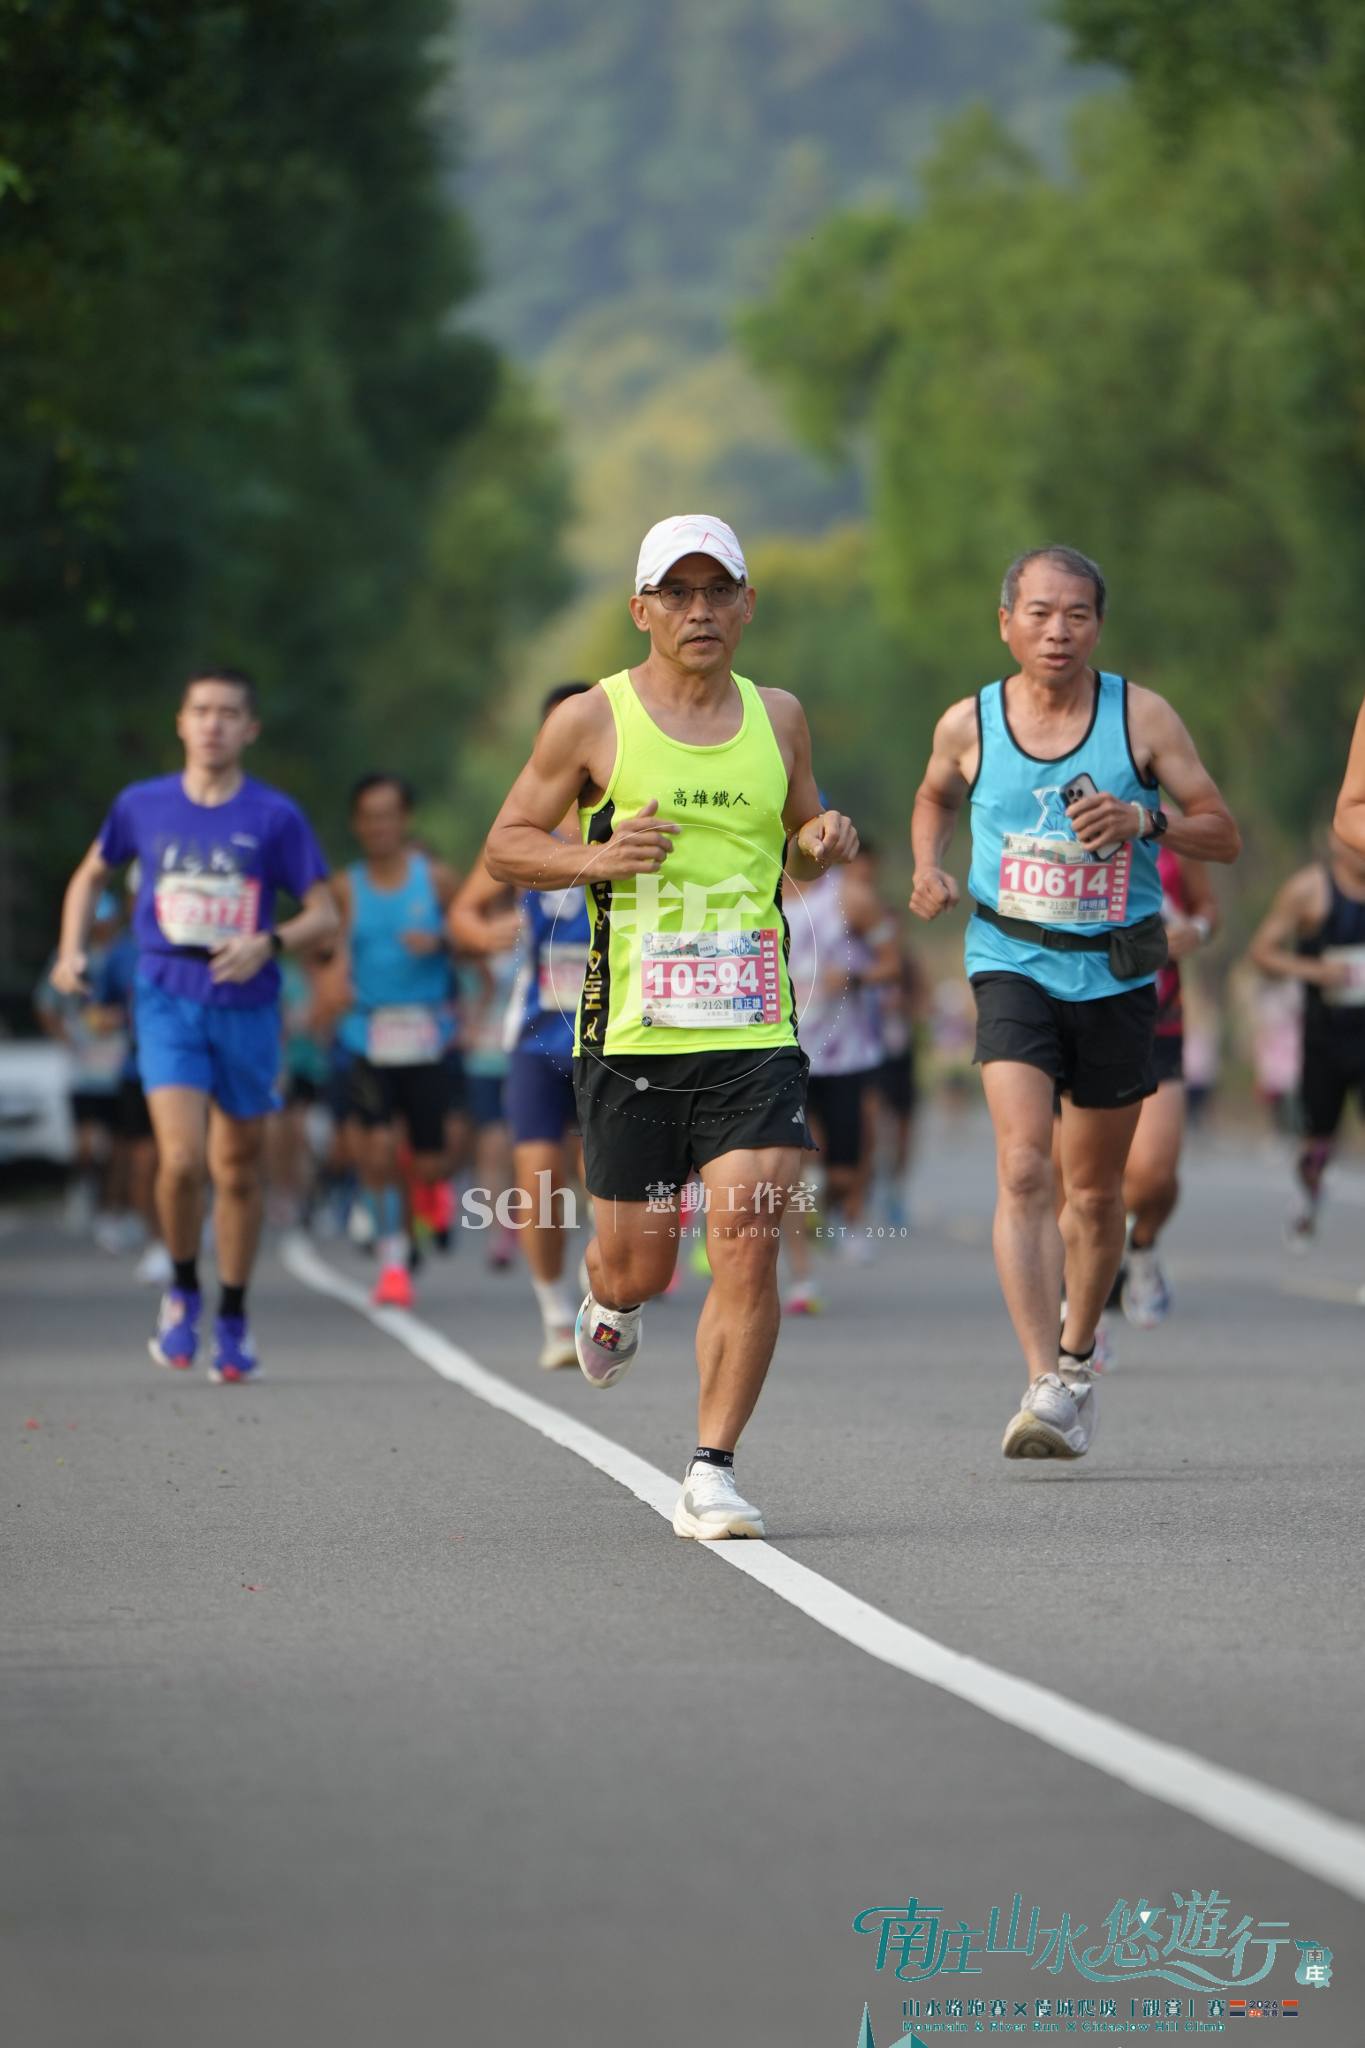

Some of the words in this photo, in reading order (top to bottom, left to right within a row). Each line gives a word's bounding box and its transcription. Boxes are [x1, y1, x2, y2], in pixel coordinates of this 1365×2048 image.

[673, 788, 751, 808] 高雄鐵人
[1005, 861, 1108, 896] 10614
[647, 960, 759, 996] 10594
[703, 999, 732, 1010] 21公里
